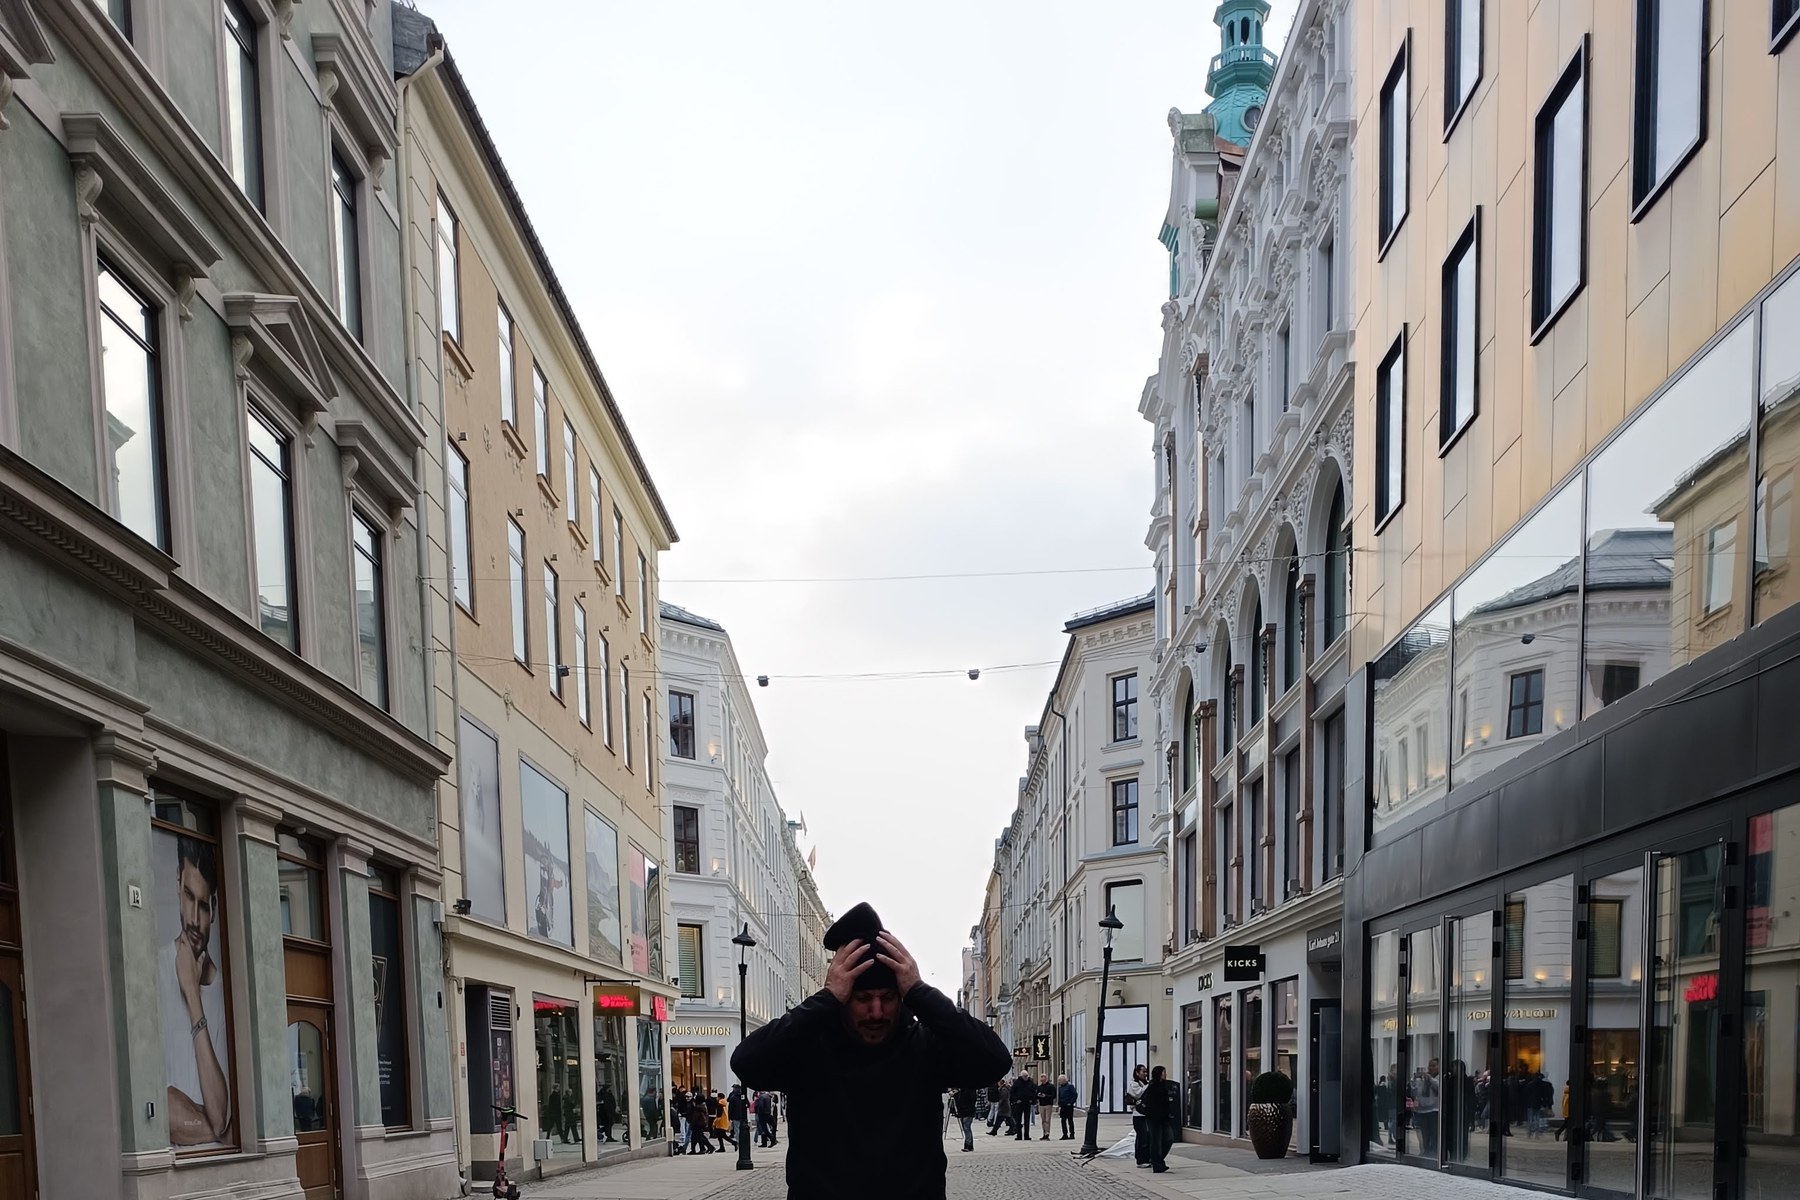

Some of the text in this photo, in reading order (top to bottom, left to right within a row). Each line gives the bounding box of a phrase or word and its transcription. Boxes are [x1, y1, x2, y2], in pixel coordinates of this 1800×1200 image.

[132, 889, 140, 904] 12
[1227, 959, 1257, 968] KICKS
[692, 1026, 731, 1036] VUITTON
